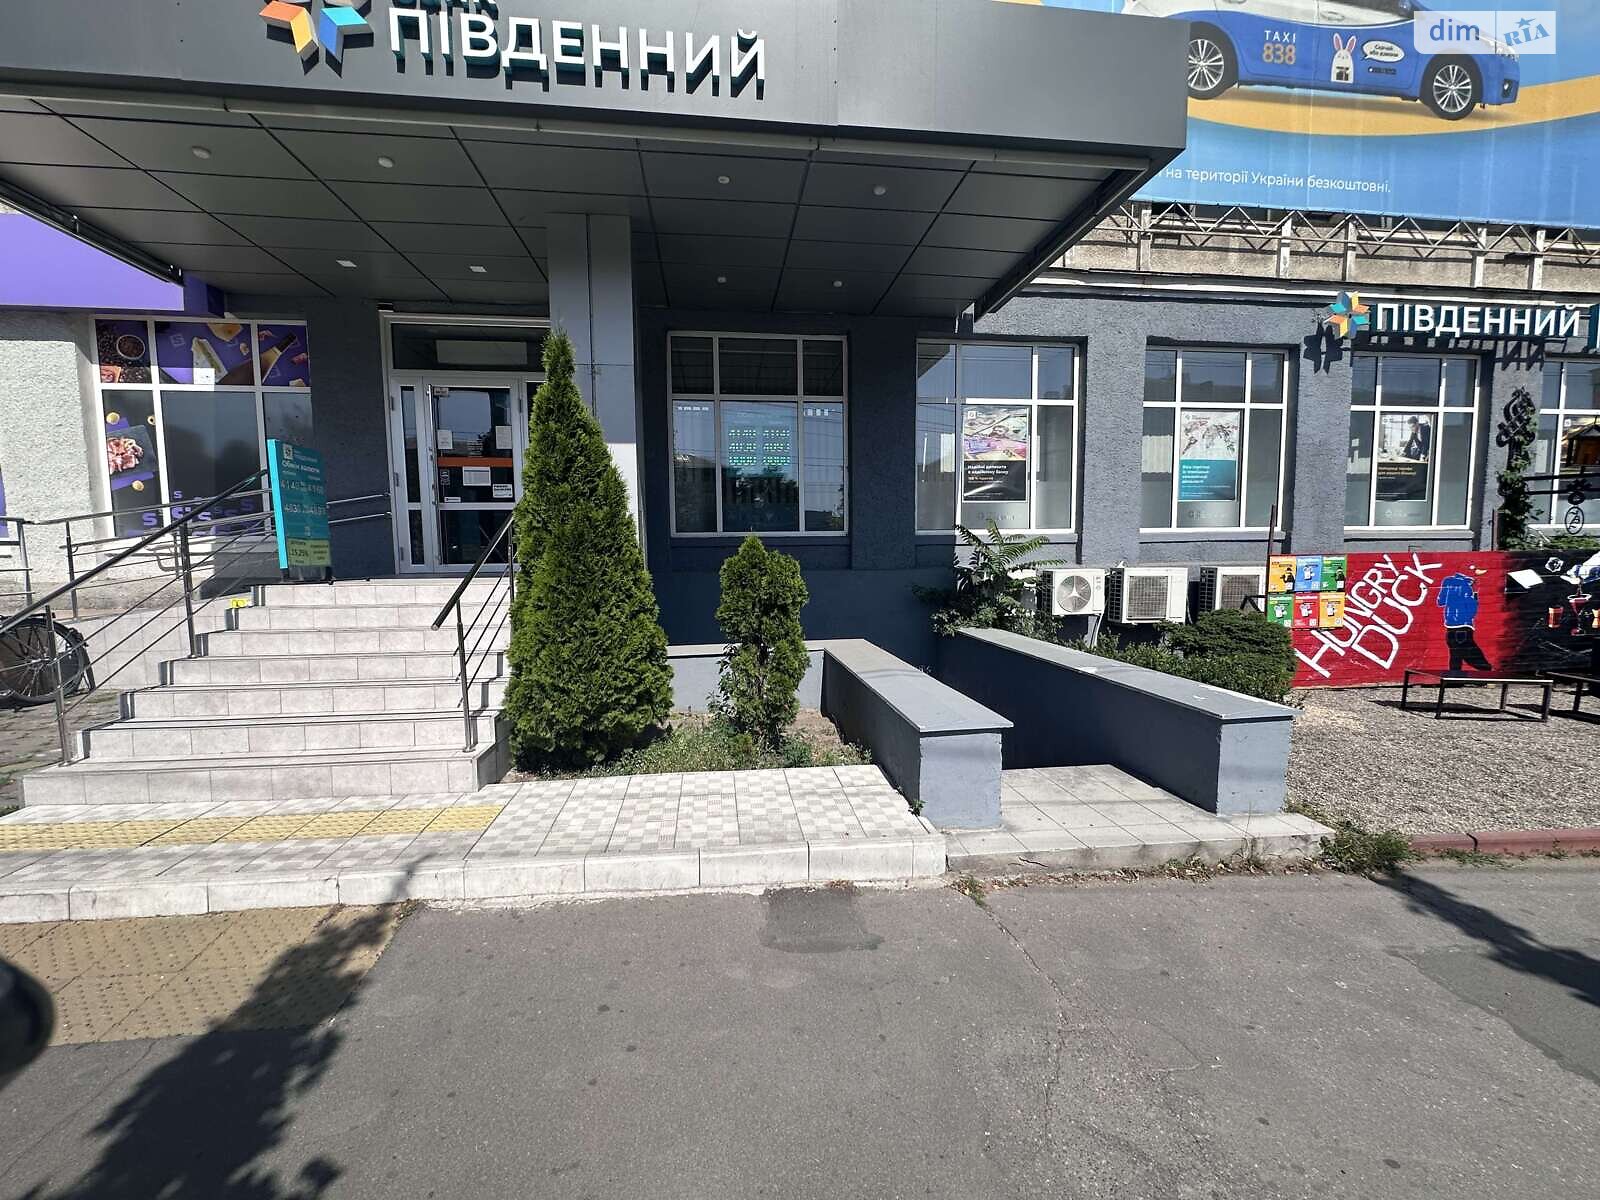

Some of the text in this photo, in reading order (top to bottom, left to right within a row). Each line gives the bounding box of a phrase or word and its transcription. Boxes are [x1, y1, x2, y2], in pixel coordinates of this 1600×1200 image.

[388, 7, 766, 81] ПІВДЕННИЙ
[1264, 30, 1296, 43] TAXI
[1263, 43, 1296, 65] 838
[1166, 169, 1391, 193] на території України безкоштовні.
[1376, 303, 1580, 337] ПІВДЕННИЙ
[1294, 554, 1400, 679] HUNGRY
[1351, 552, 1443, 670] DUCK
